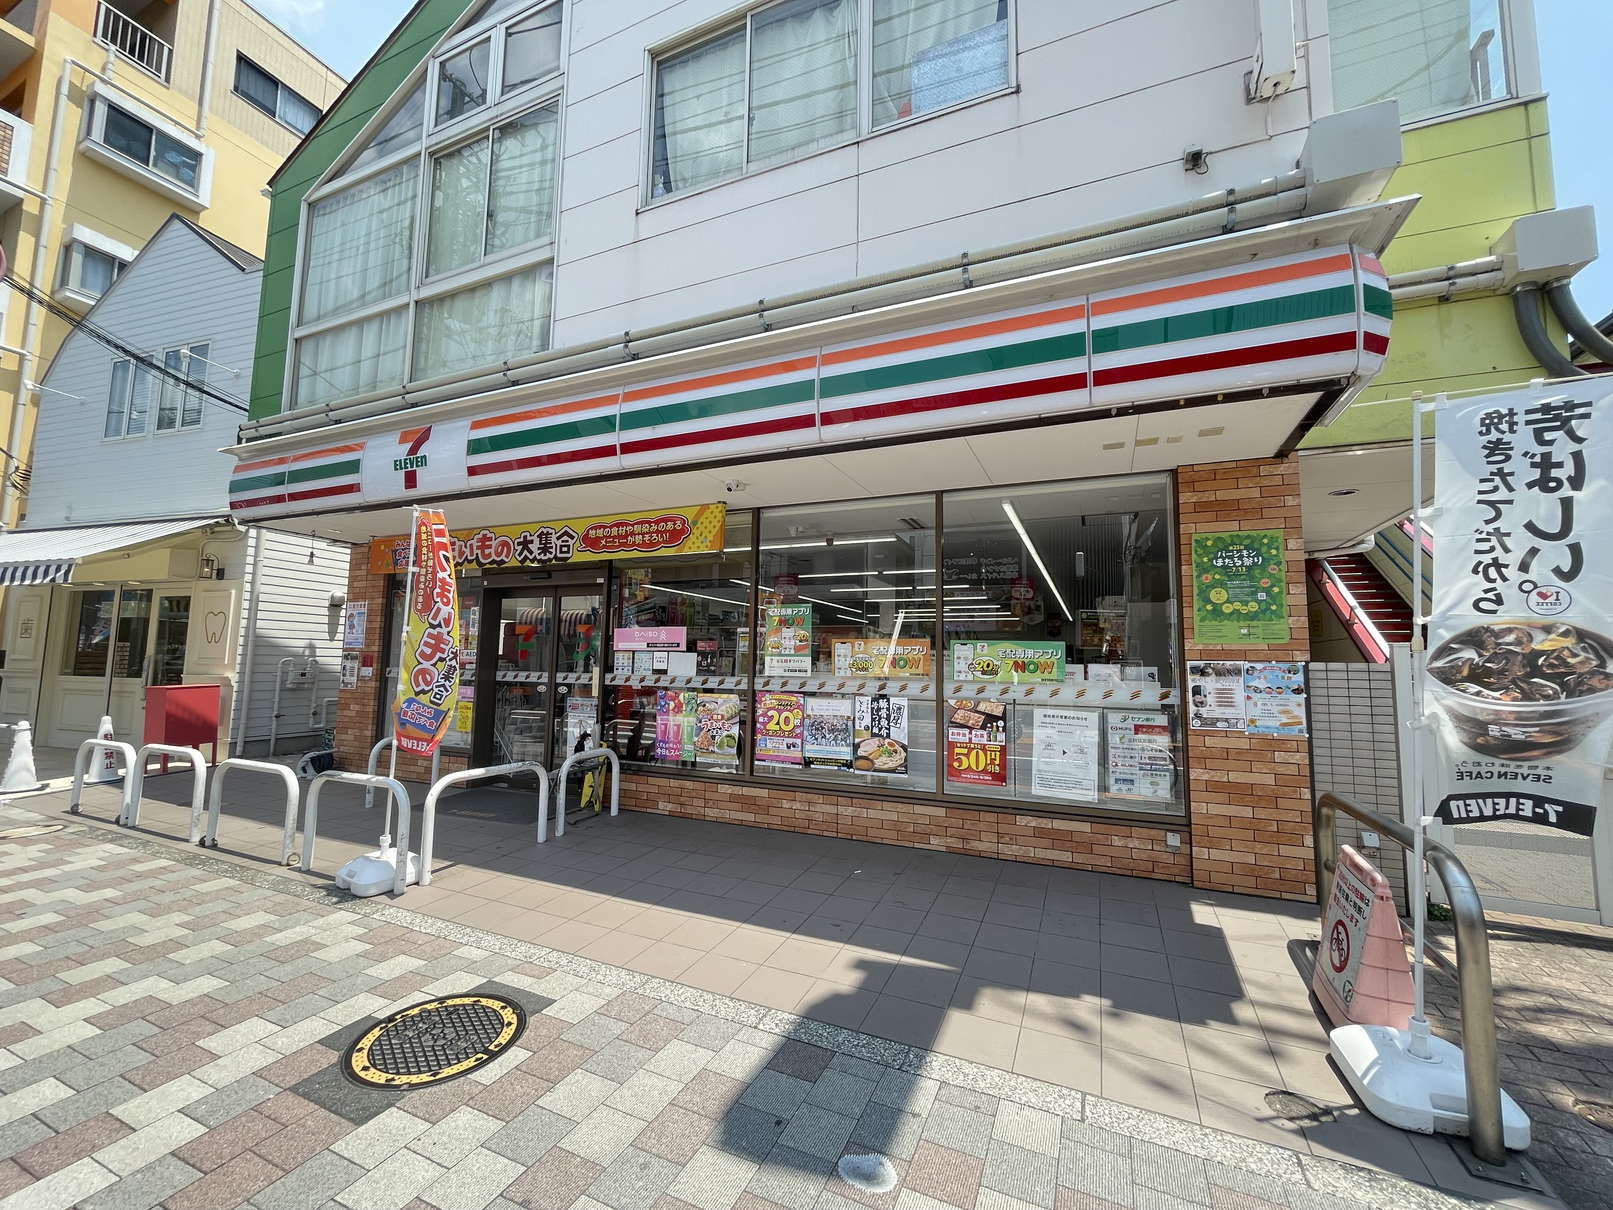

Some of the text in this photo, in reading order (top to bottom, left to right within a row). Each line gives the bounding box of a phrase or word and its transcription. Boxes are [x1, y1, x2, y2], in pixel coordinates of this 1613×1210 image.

[588, 520, 683, 538] 地域の食材や馴染みのある
[1213, 556, 1262, 567] ほたる祭り
[1217, 550, 1257, 558] パーシモン
[1004, 660, 1055, 674] 7NOW
[766, 710, 795, 731] 20
[103, 732, 115, 770] 駐禁止
